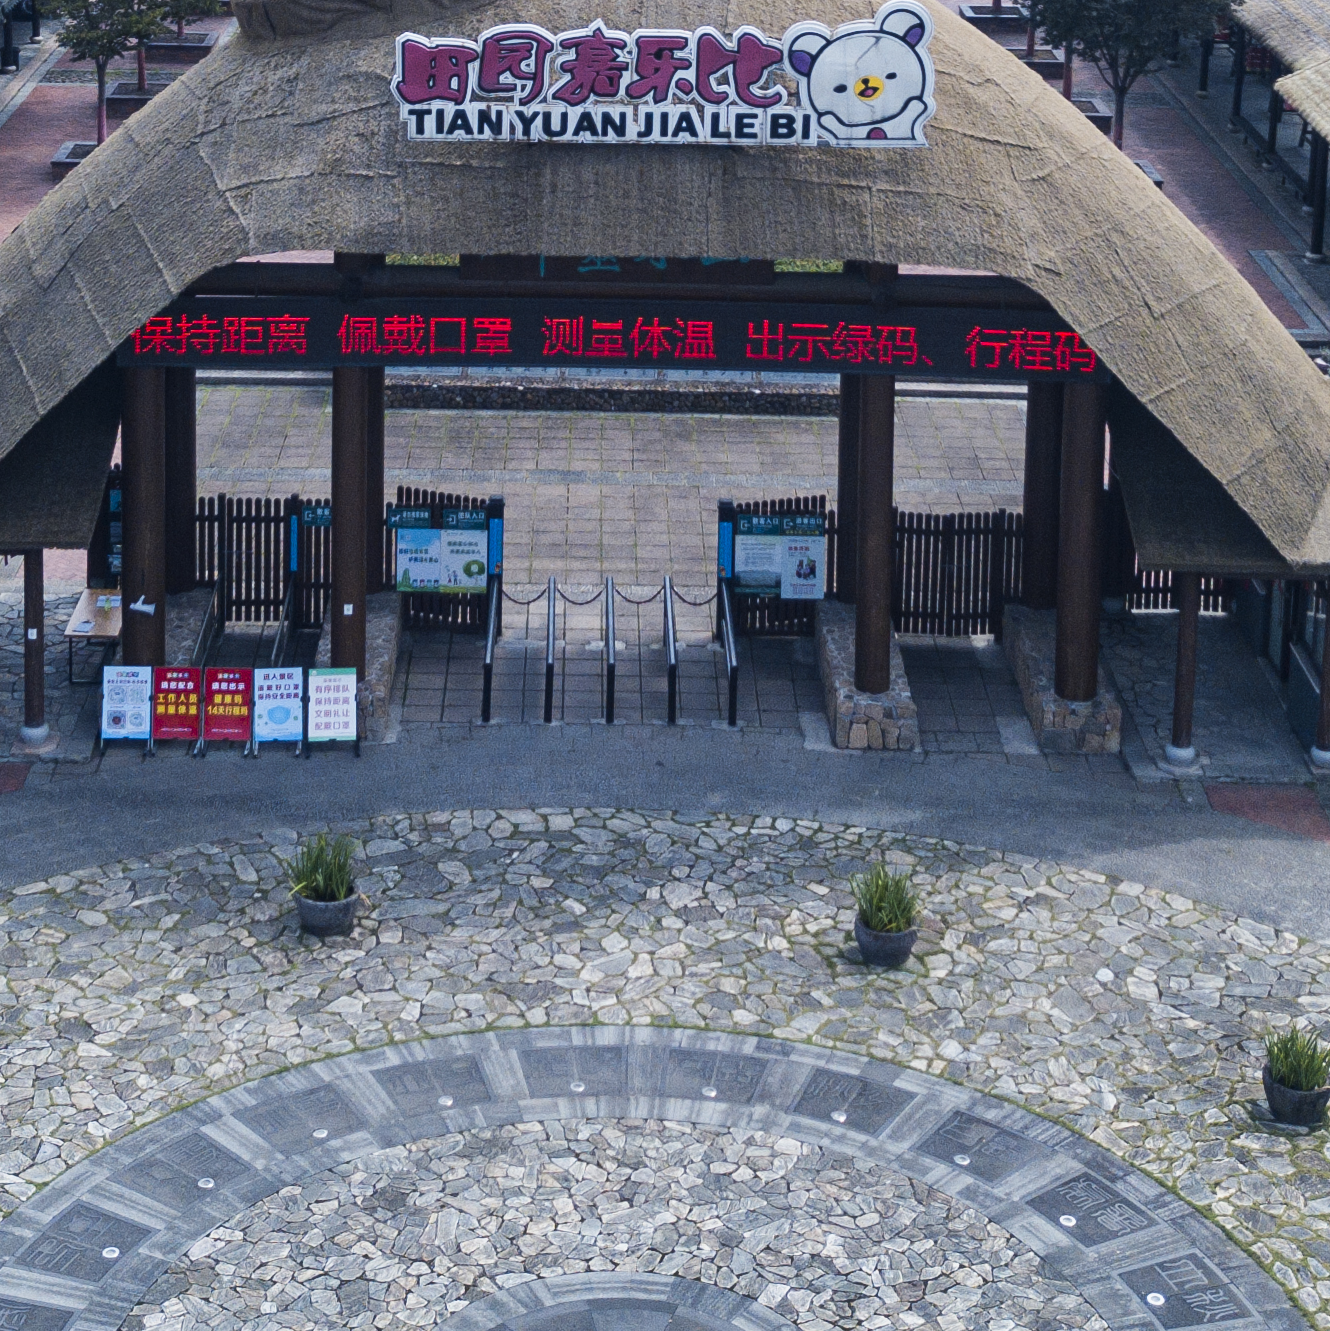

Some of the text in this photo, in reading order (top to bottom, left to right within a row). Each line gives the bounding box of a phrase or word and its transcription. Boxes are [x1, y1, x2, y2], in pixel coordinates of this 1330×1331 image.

[131, 314, 310, 356] 保持距离
[337, 314, 513, 357] 佩戴口罩
[541, 314, 716, 360] 测量体温
[965, 325, 1096, 372] 行程码
[157, 693, 198, 703] 工作人员
[314, 709, 350, 718] 文明礼让
